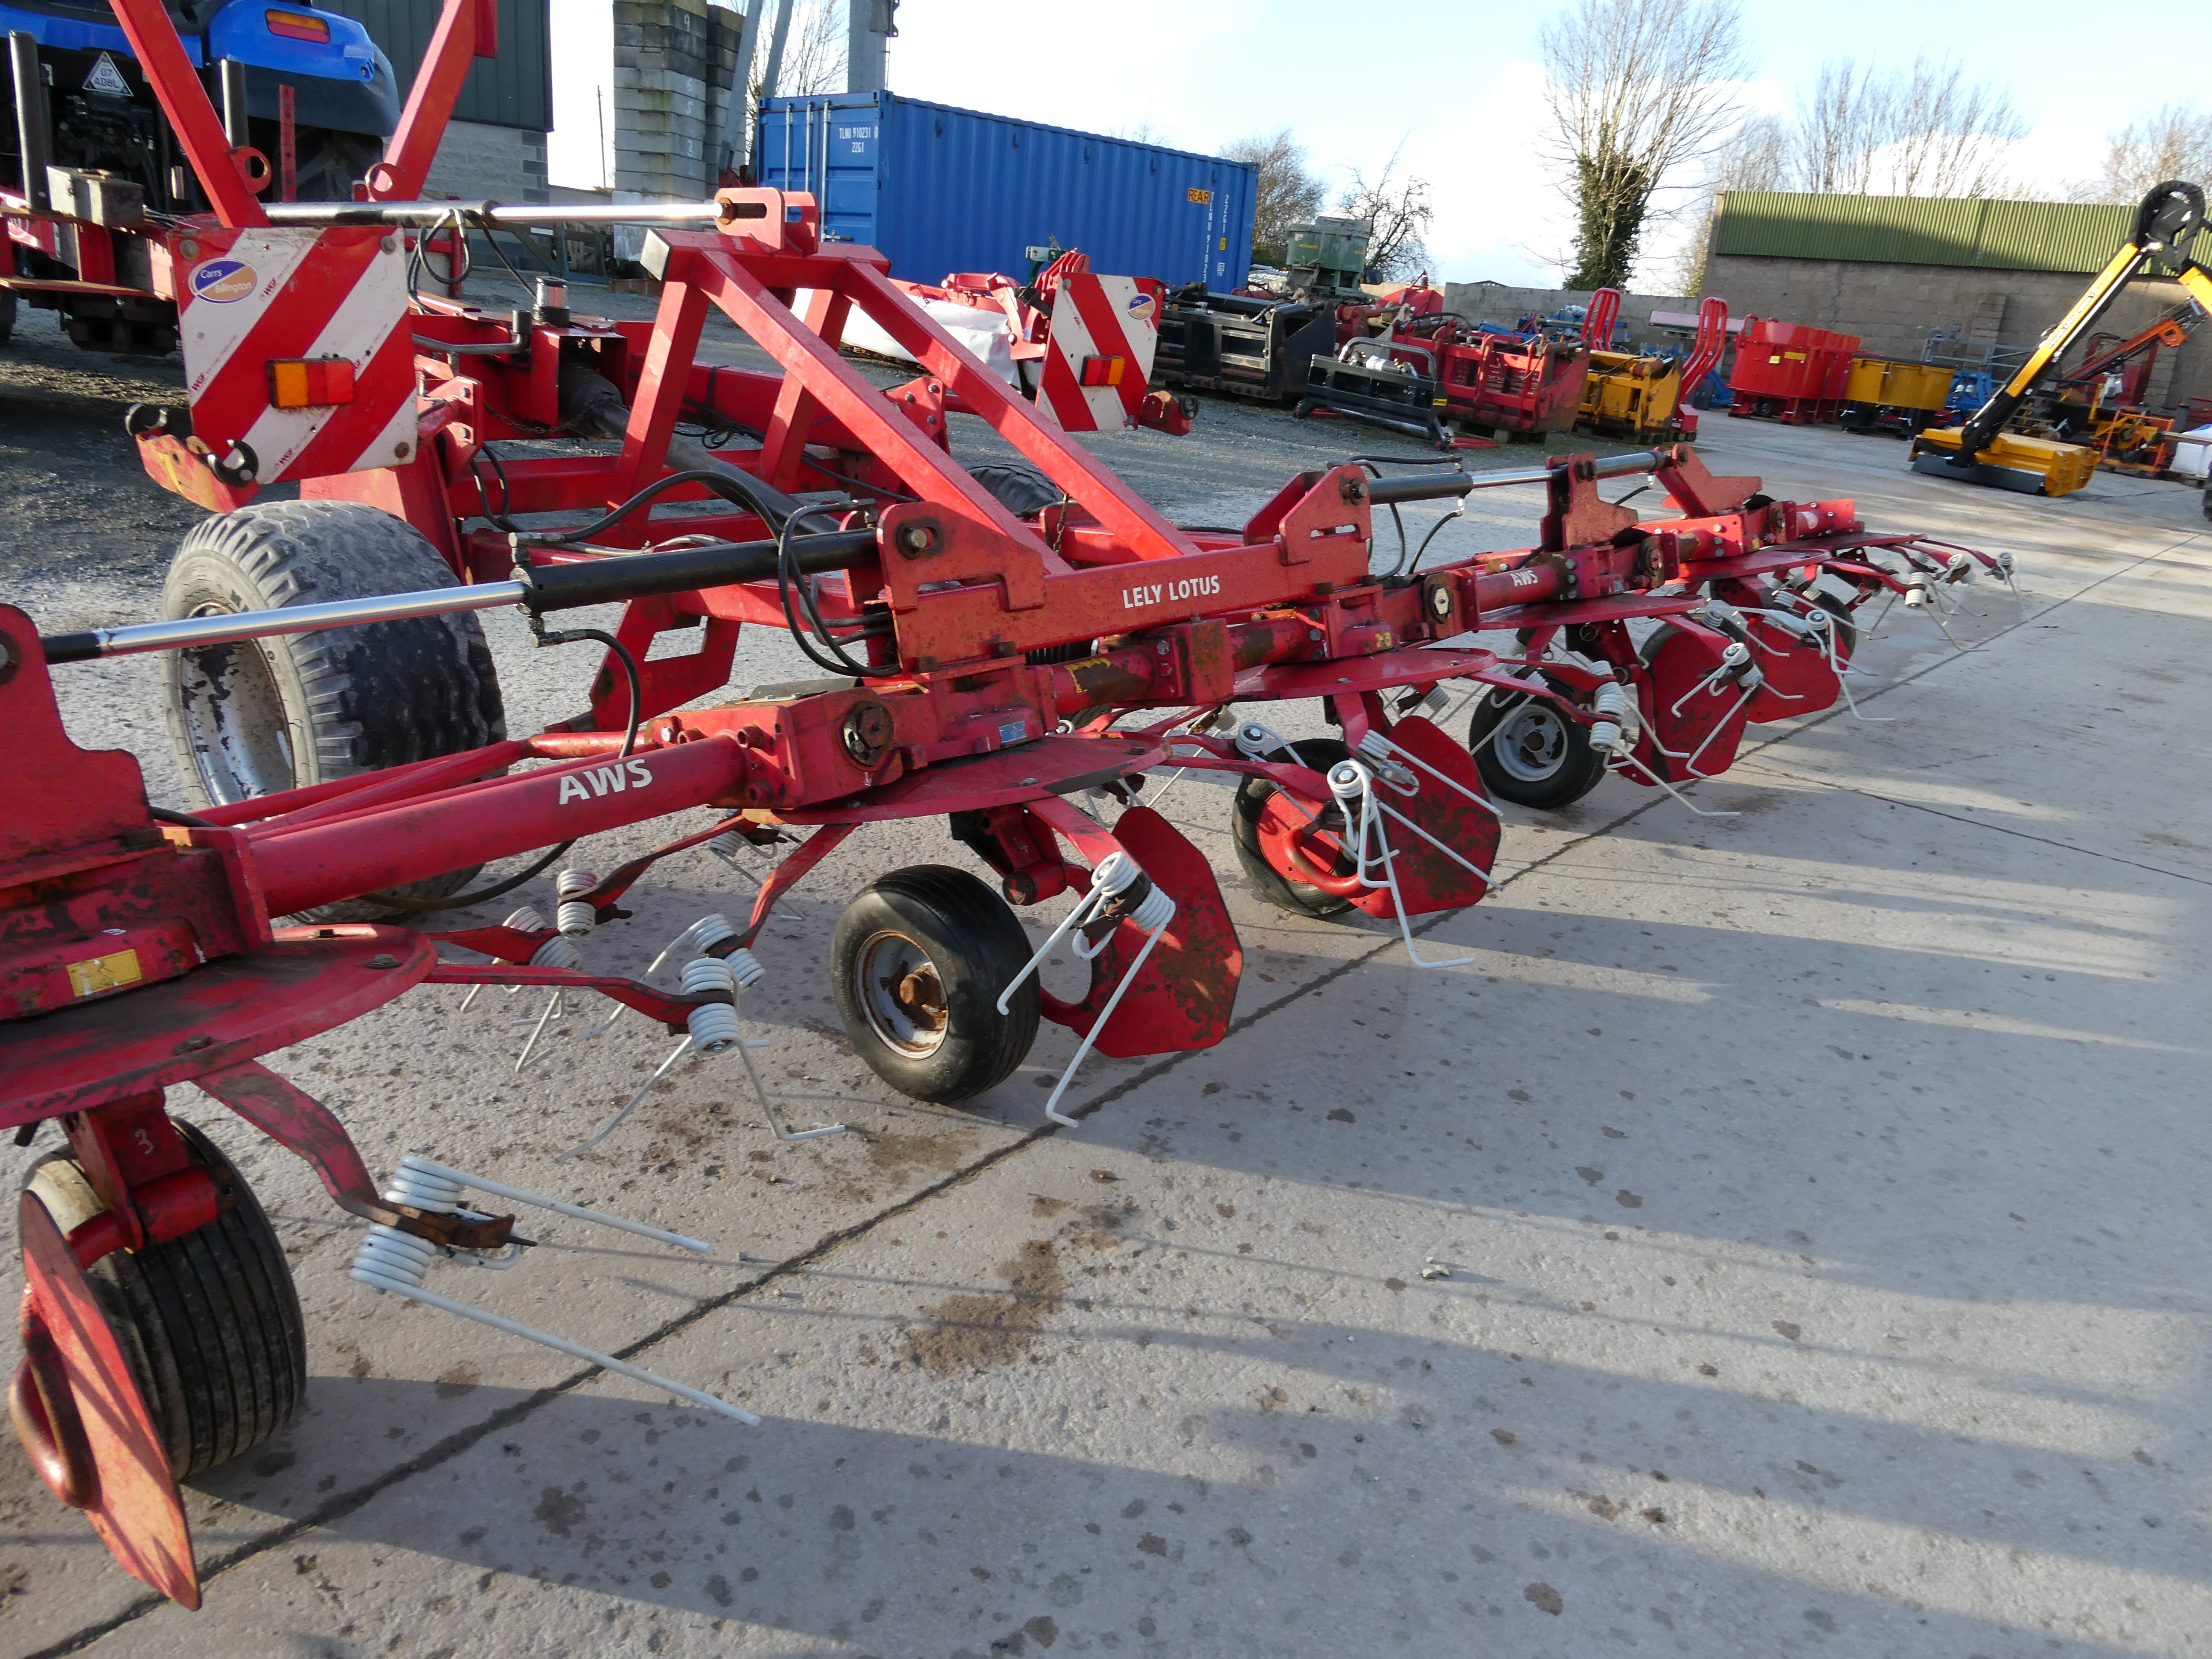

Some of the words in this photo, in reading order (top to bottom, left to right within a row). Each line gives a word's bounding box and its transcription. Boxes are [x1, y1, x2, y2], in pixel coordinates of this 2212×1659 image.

[686, 79, 693, 91] 6
[853, 127, 871, 138] 910231
[852, 142, 864, 153] 22G1
[1189, 189, 1209, 203] REAR
[215, 282, 252, 293] Billington
[1510, 570, 1539, 586] AWS
[1123, 584, 1162, 608] LELY
[1168, 575, 1220, 600] LOTUS
[559, 759, 653, 804] AWS
[134, 1129, 154, 1155] 3
